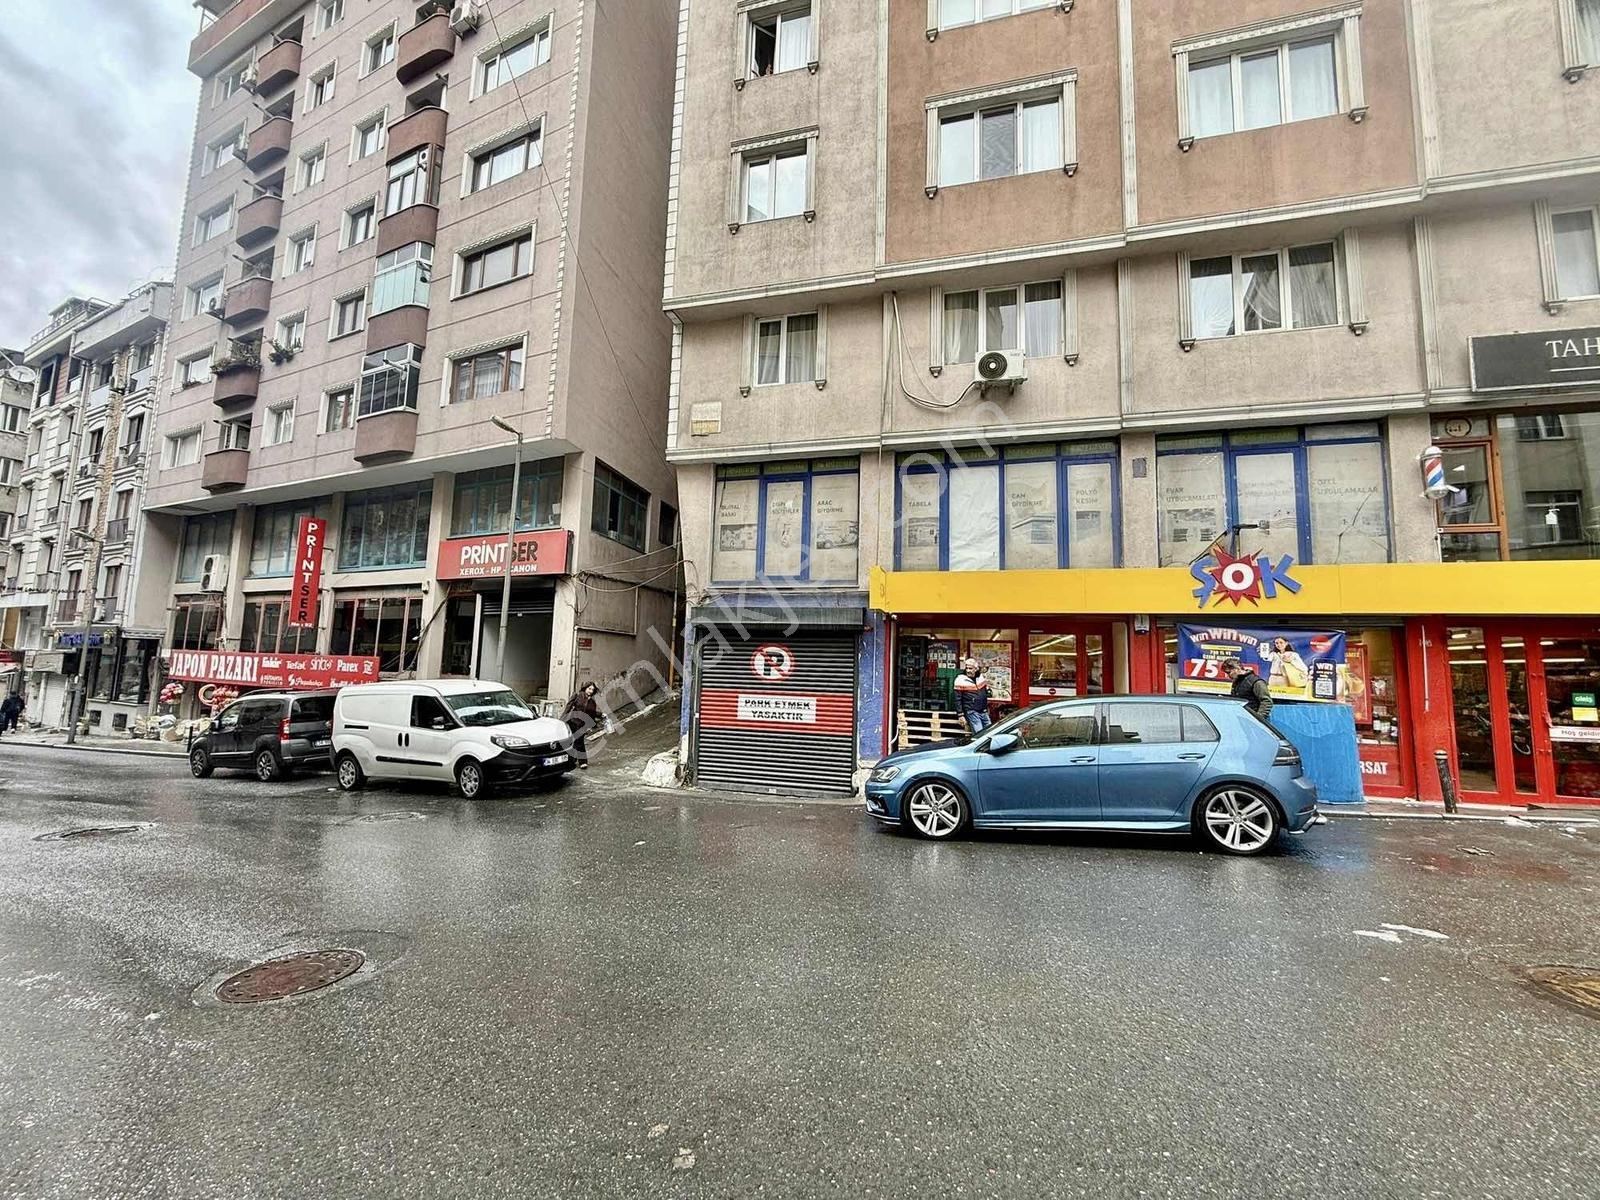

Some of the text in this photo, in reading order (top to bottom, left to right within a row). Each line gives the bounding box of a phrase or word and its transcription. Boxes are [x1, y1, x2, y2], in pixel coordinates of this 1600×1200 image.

[908, 500, 932, 508] TABELA
[460, 567, 485, 576] XEROX
[491, 566, 502, 574] HP
[1190, 553, 1302, 609] ŞOK
[169, 652, 260, 682] JAPON PAZARI
[286, 660, 307, 671] Tefal
[337, 659, 358, 673] Parex
[1190, 659, 1219, 678] 75
[744, 699, 811, 710] PARK ETMEK
[751, 711, 804, 721] YASAKTIR
